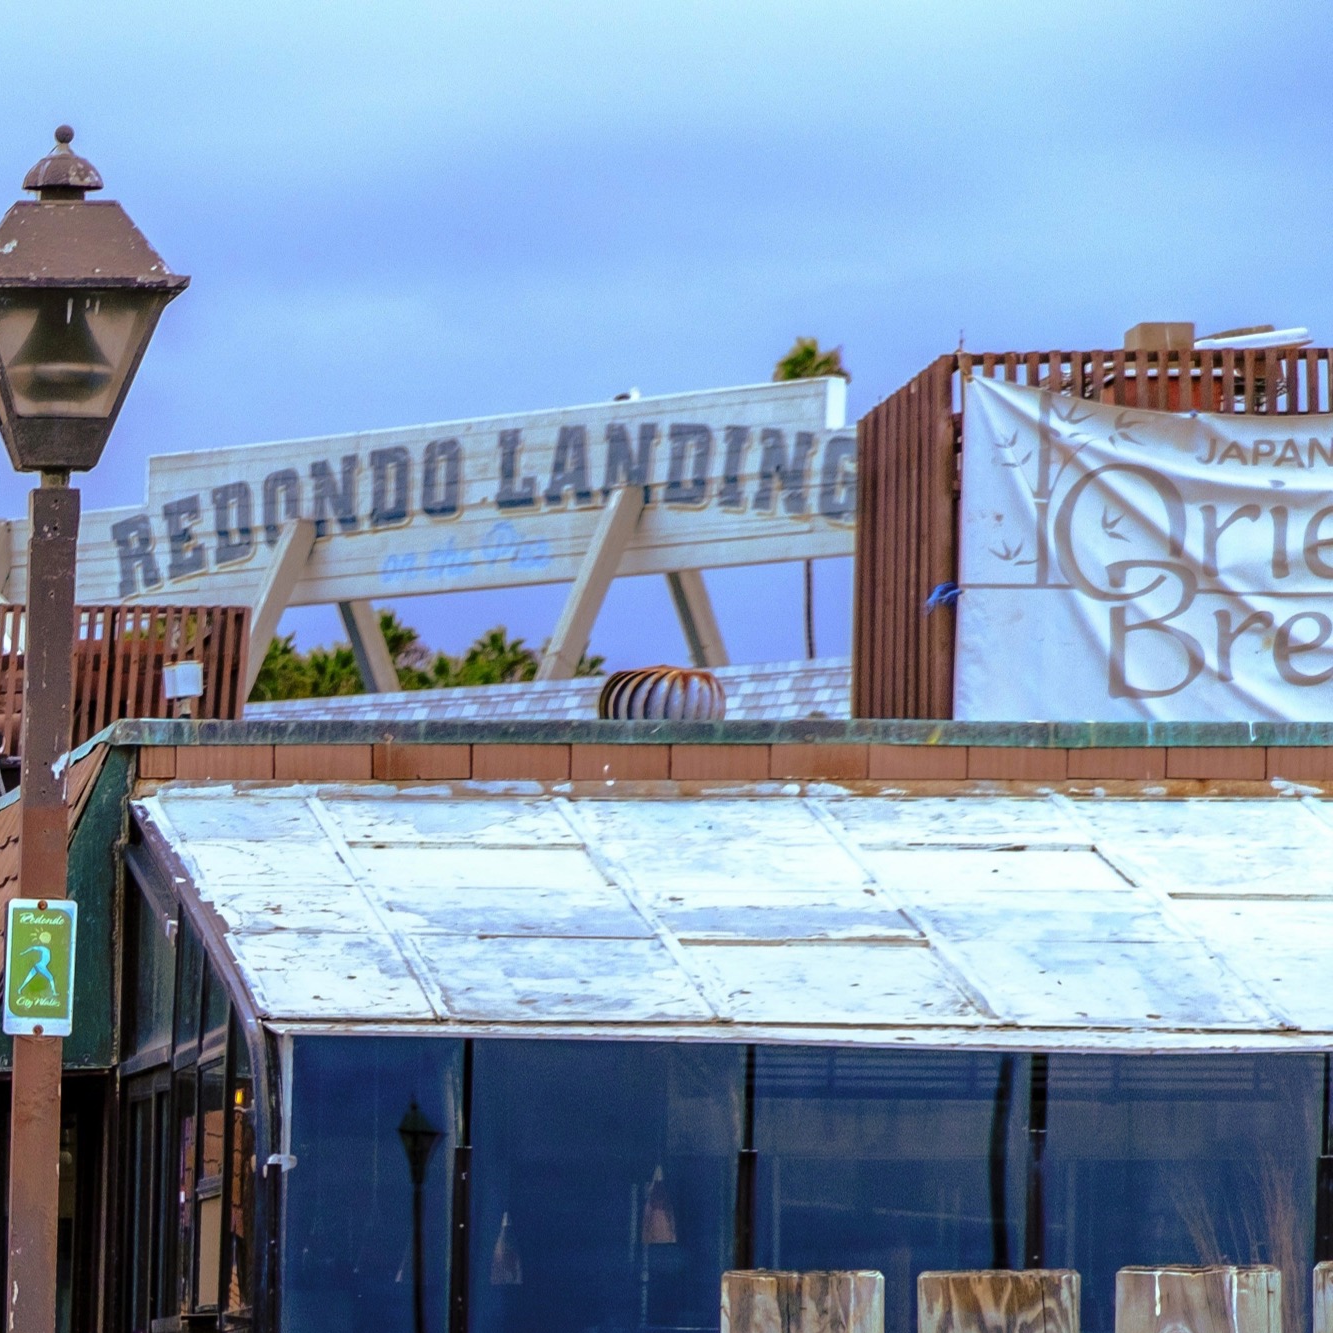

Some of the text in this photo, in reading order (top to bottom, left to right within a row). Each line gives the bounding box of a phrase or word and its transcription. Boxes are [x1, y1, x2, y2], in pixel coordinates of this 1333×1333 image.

[112, 422, 857, 606] REDONDO LANDING
[16, 996, 33, 1009] City
